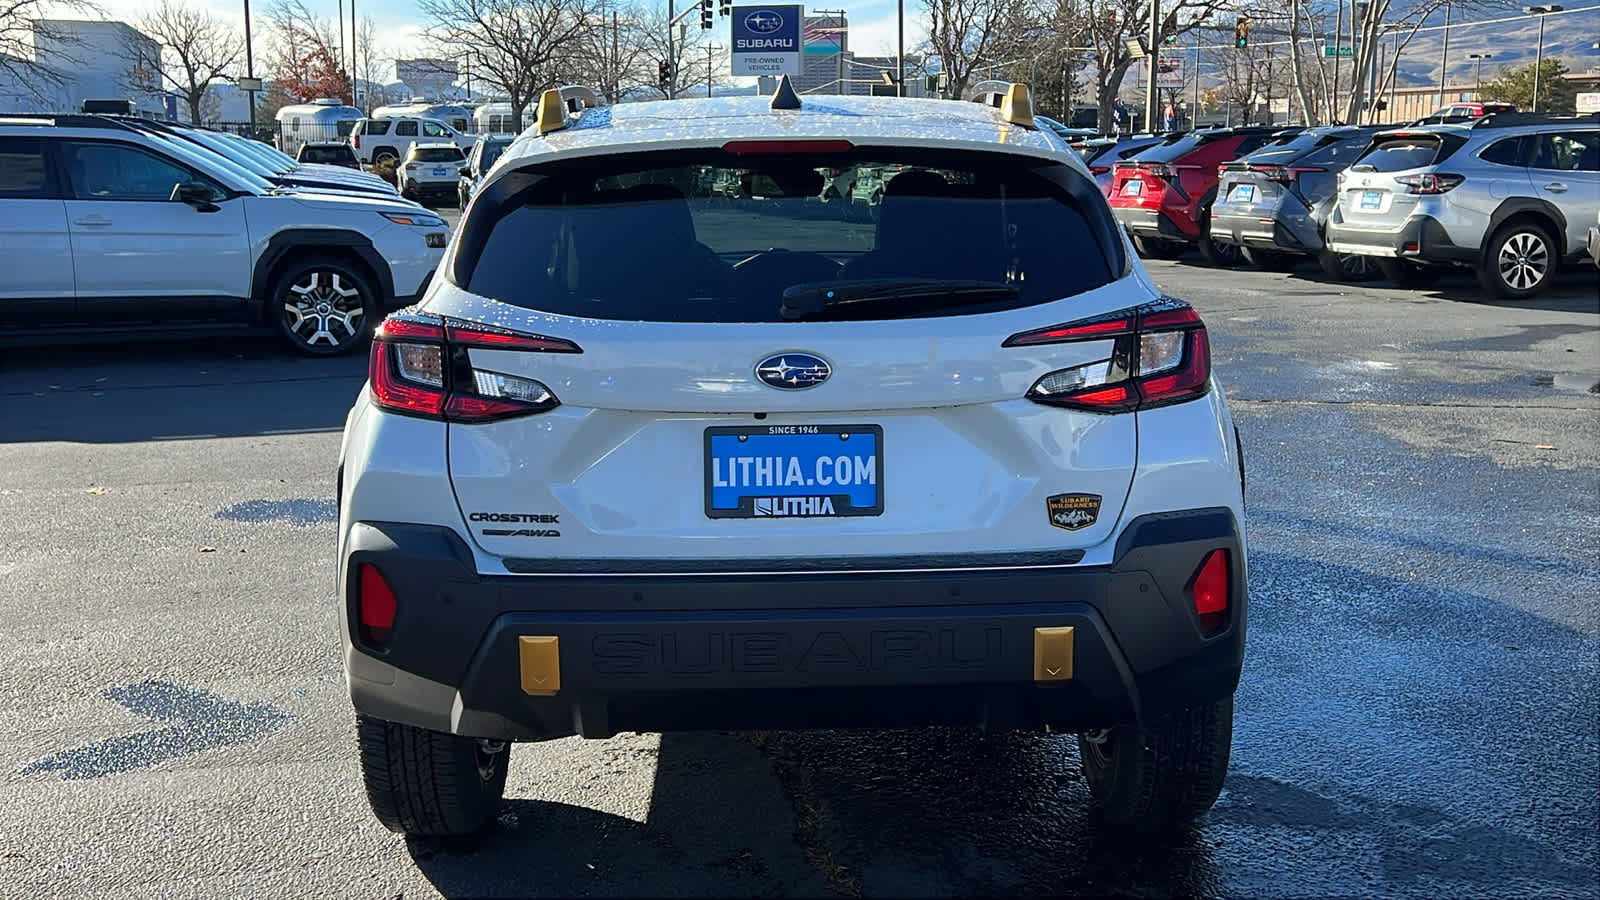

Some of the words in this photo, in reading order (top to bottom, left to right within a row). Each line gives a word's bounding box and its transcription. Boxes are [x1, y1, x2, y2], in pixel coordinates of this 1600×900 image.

[737, 39, 793, 48] SUBARU
[799, 426, 819, 434] 1946
[712, 455, 877, 487] LITHIA.COM
[773, 497, 835, 515] LITHIA
[468, 512, 561, 523] CROSSTREK
[511, 529, 561, 537] AWD
[592, 627, 1007, 674] SUBARU
